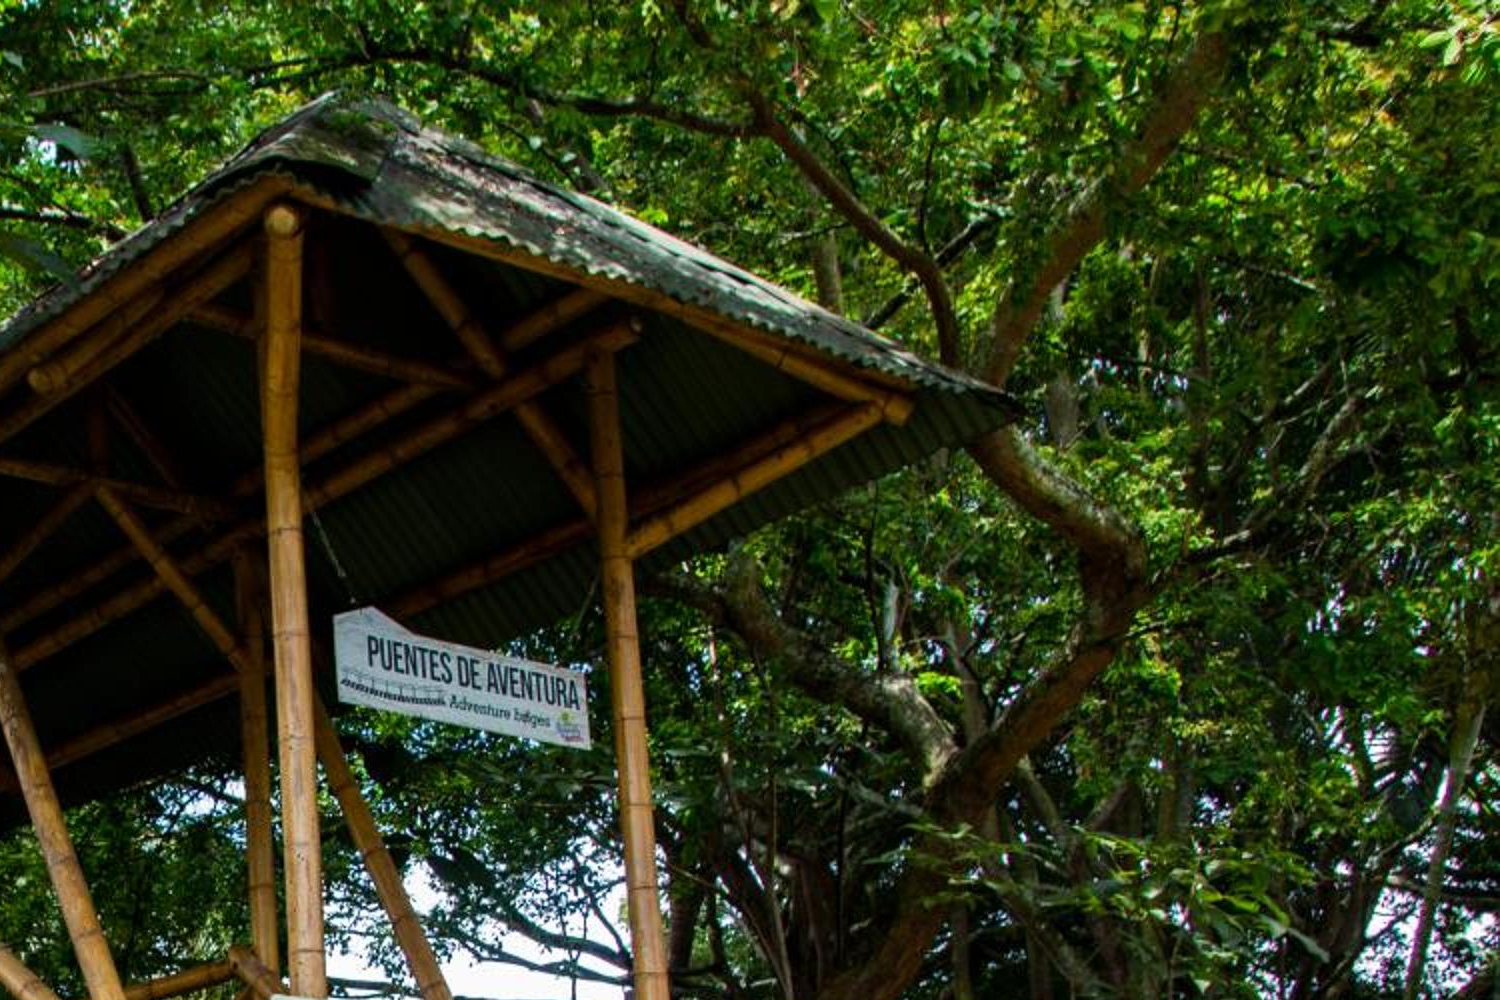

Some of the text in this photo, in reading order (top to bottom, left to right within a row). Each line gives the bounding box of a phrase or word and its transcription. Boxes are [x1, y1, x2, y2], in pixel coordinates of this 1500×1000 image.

[367, 635, 581, 711] PUENTES DE AVENTURA
[449, 694, 511, 721] Adventure
